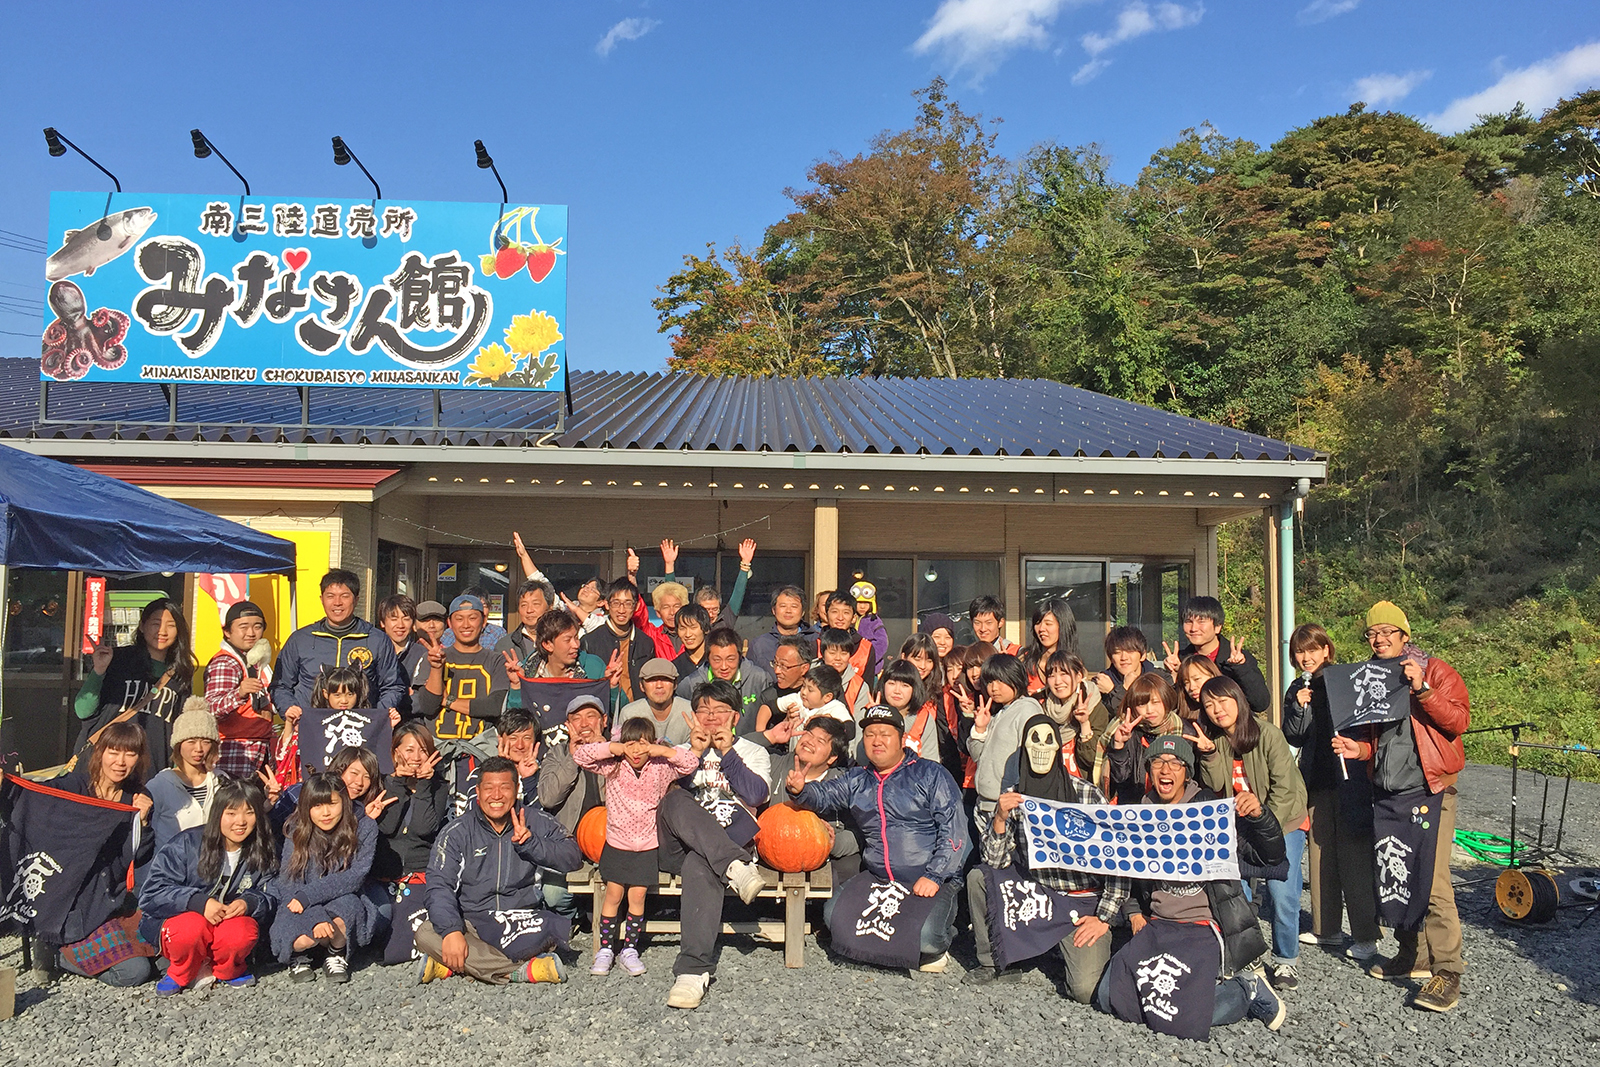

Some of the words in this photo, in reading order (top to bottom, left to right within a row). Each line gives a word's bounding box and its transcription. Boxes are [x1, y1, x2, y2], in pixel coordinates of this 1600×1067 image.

[201, 203, 416, 239] 南三陸直売所
[134, 237, 493, 364] みなさん館
[141, 366, 257, 380] MINAMISANRIKU
[263, 369, 366, 382] CHOKUBAISYO
[369, 370, 460, 383] MINASANKAN
[866, 706, 893, 718] Kings
